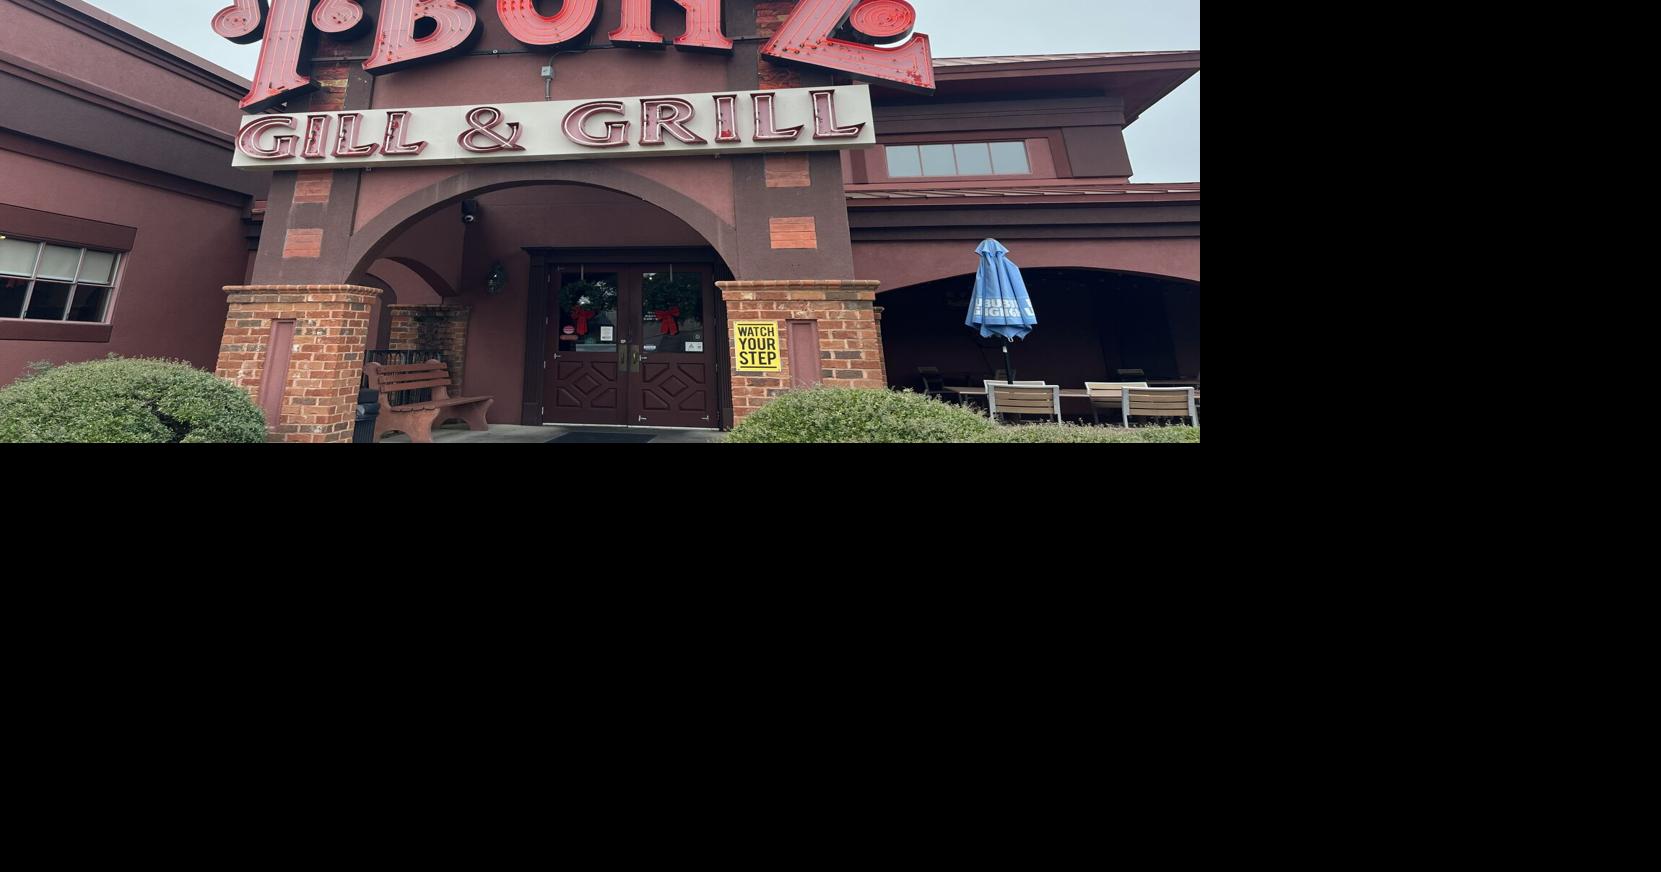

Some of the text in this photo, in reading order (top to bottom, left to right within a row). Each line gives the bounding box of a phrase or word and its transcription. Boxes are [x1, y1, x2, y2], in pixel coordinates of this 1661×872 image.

[235, 88, 866, 160] GILL & GRILL
[737, 326, 775, 337] WATCH
[738, 337, 776, 350] YOUR
[739, 351, 777, 365] STEP
